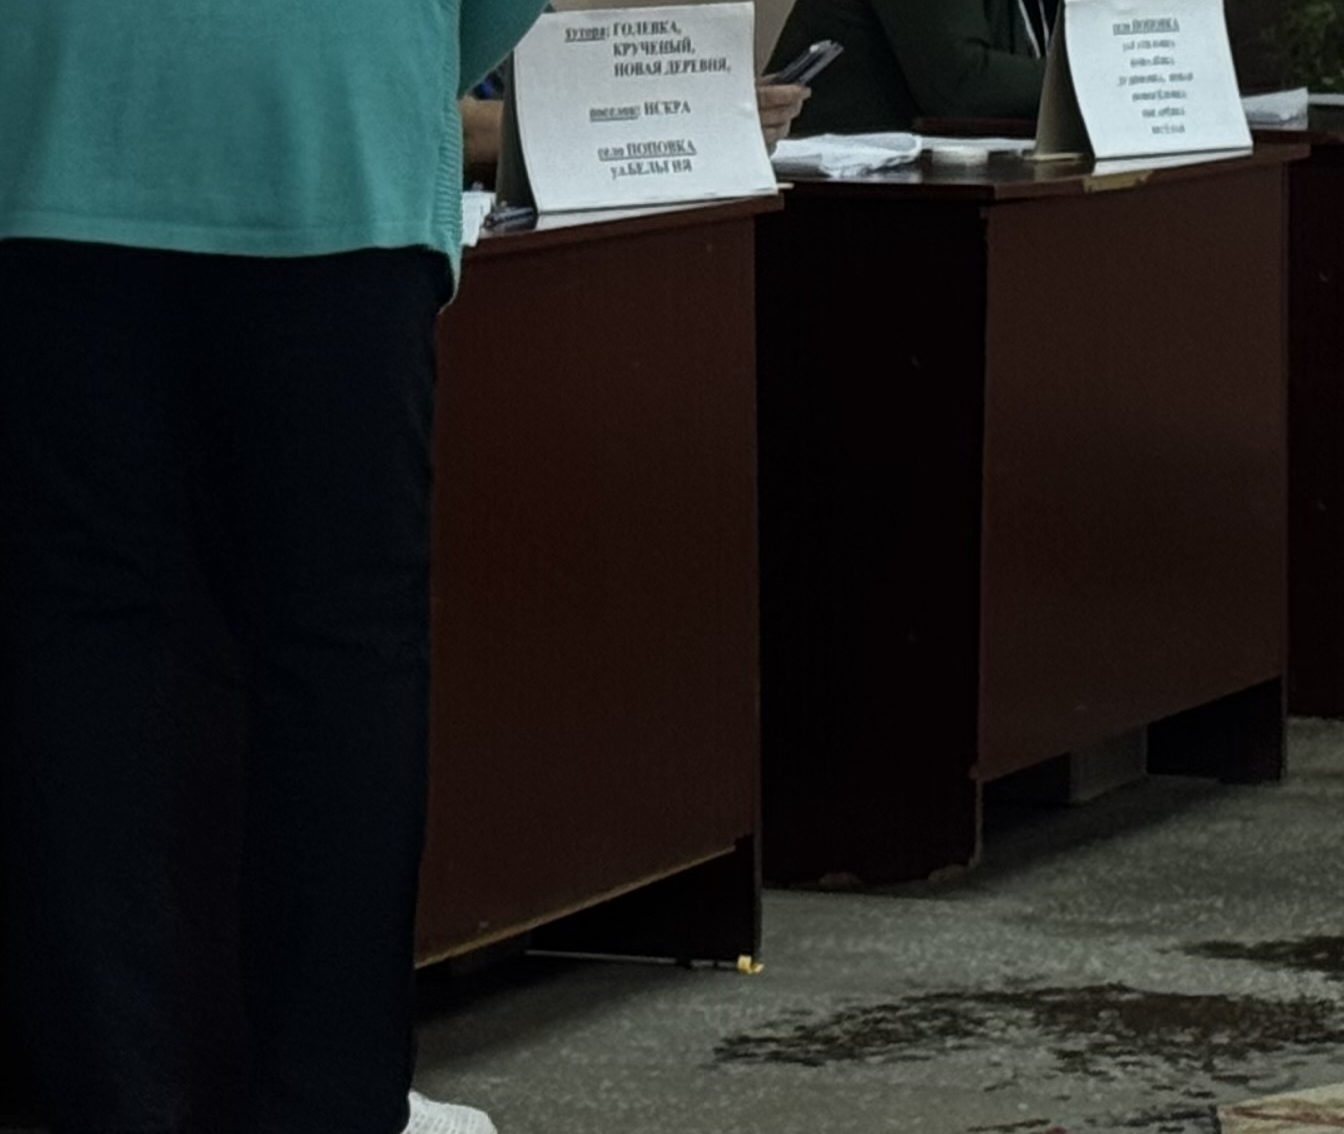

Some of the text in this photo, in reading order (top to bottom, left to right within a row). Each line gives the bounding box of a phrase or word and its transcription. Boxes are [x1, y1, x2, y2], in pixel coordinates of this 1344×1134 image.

[614, 60, 662, 77] НОВАЯ
[644, 100, 692, 116] ИСКРА
[626, 139, 697, 158] ПОПОВКА
